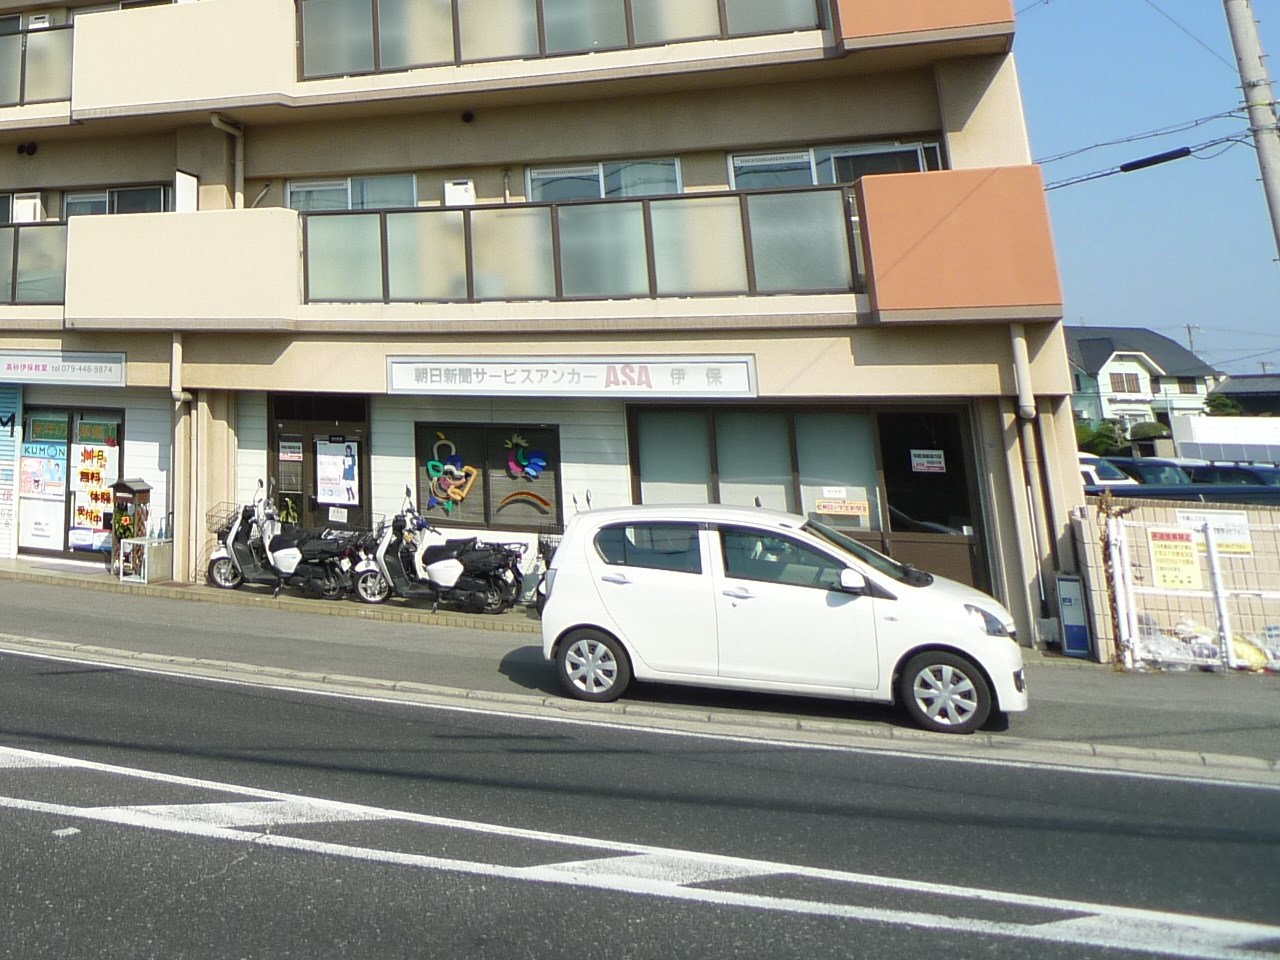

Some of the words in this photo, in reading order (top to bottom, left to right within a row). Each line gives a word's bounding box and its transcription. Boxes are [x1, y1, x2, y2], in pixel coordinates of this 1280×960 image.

[6, 363, 48, 372] 高砂伊保教室
[413, 367, 597, 385] 朝日新聞サービスアンカー
[604, 364, 653, 389] ASA
[670, 368, 723, 386] 伊保
[24, 445, 66, 458] KUMON
